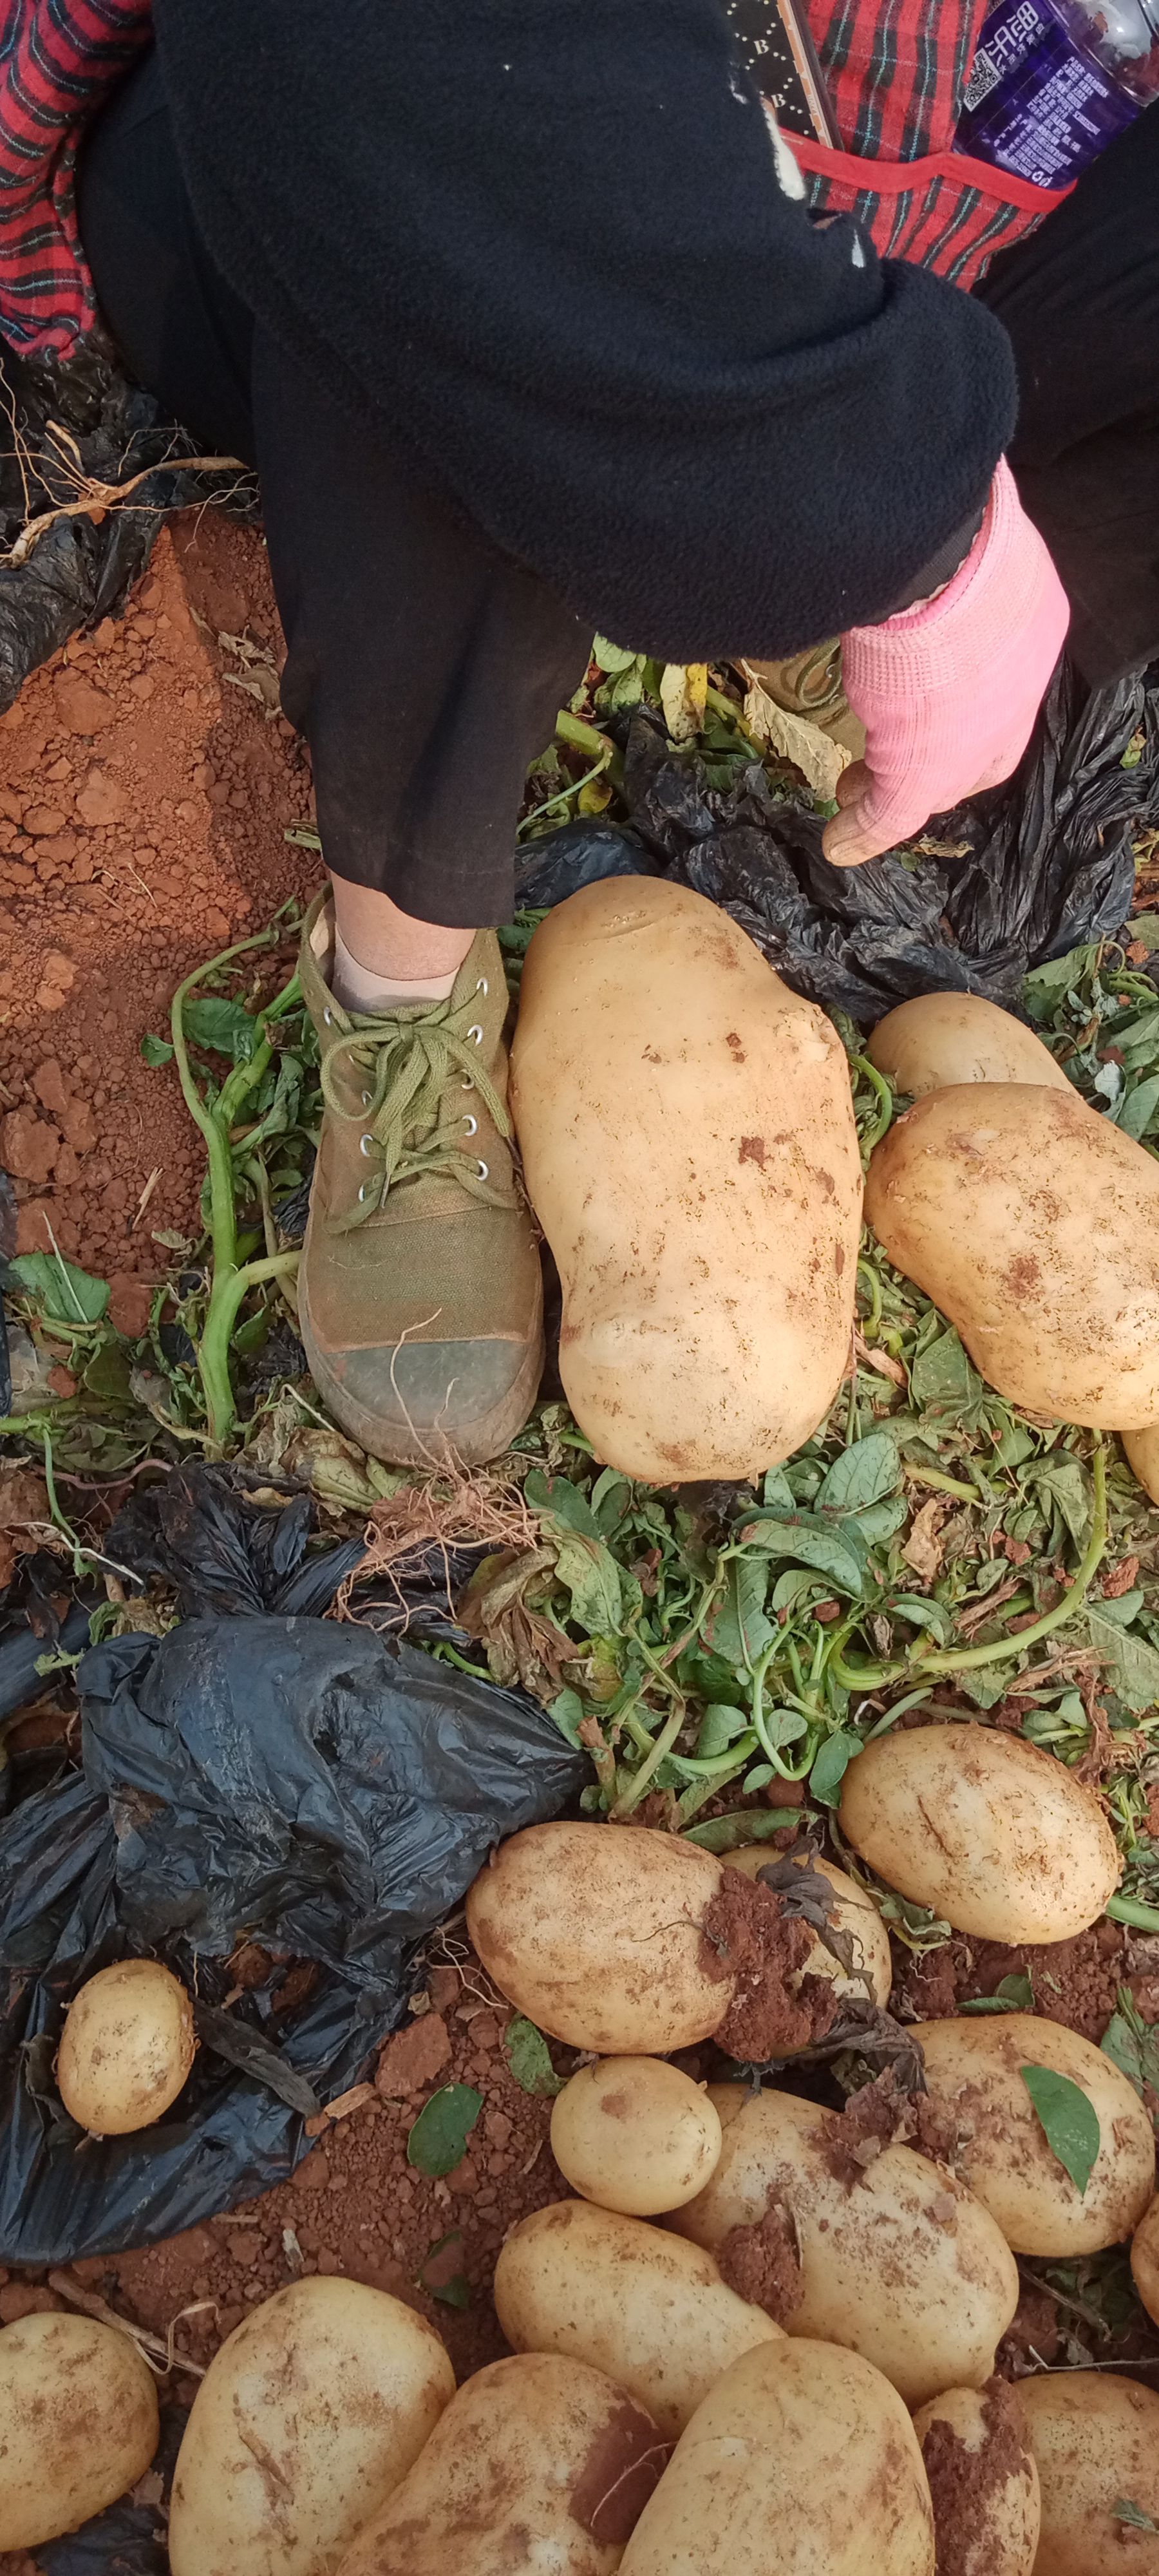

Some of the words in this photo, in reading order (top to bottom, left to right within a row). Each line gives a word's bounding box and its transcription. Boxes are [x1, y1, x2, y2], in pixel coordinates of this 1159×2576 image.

[753, 39, 769, 55] B
[985, 1, 1039, 66] 思乐
[999, 23, 1045, 75] 包装饮用水
[771, 93, 787, 109] B
